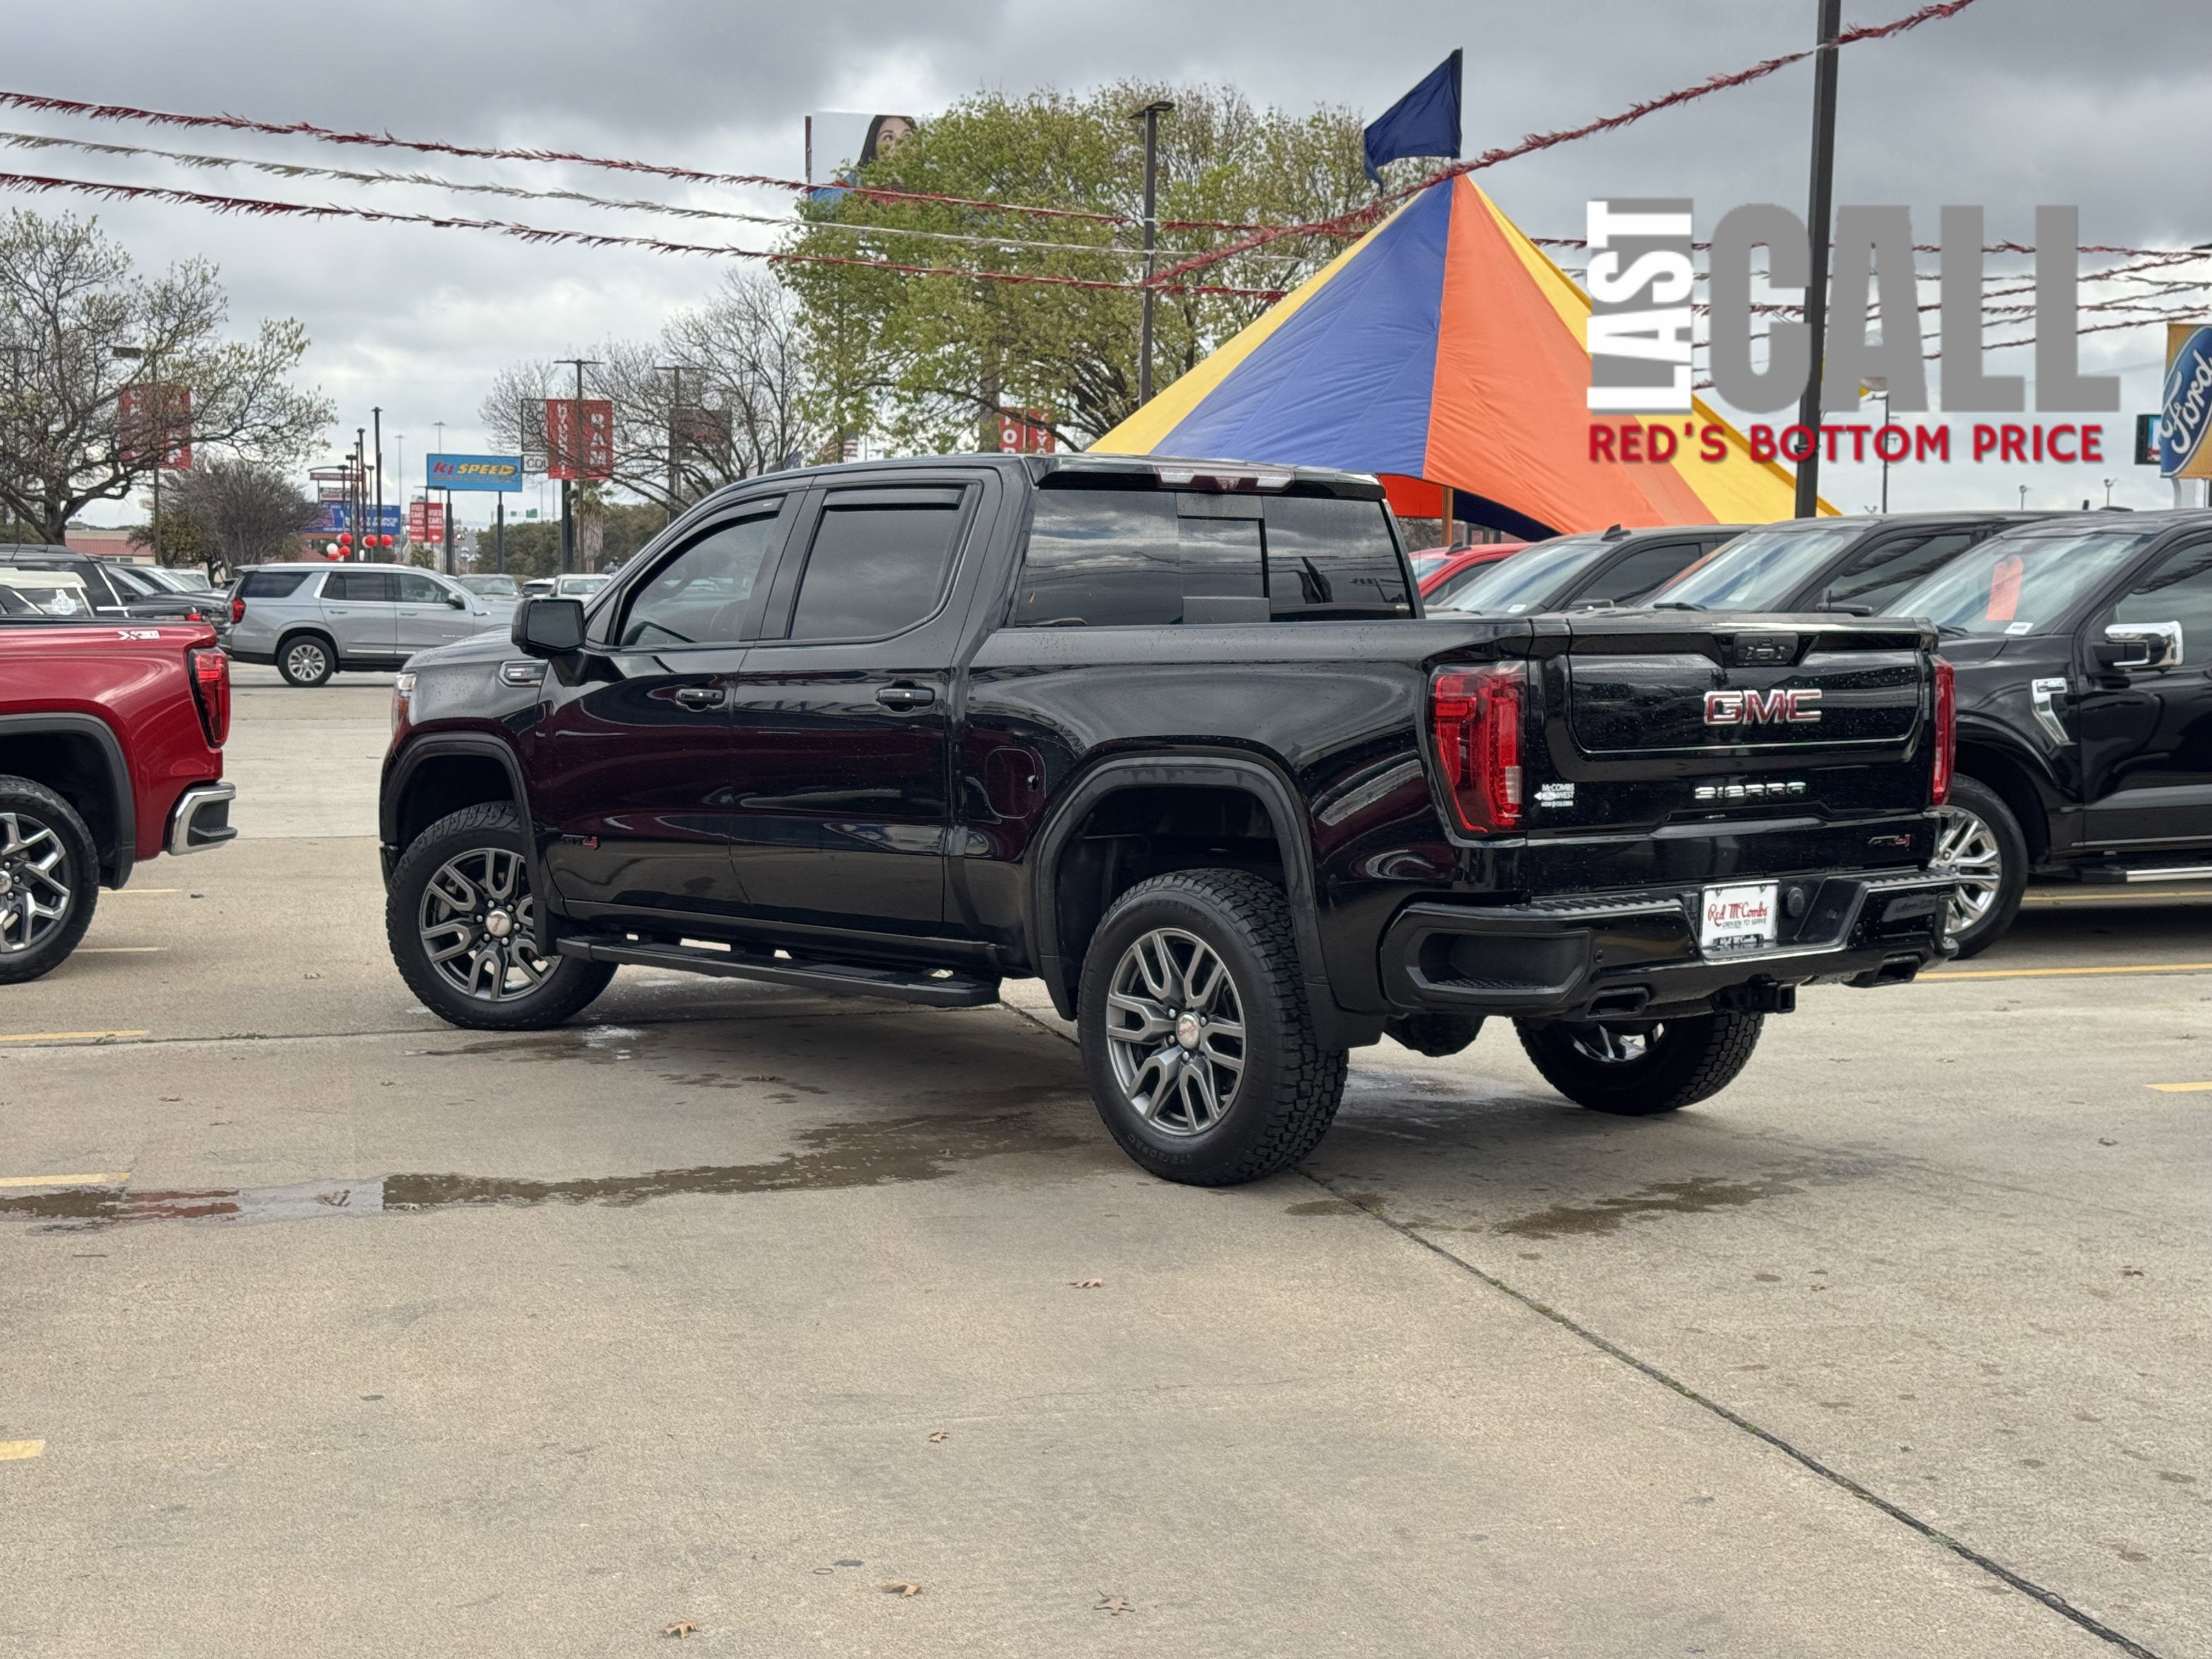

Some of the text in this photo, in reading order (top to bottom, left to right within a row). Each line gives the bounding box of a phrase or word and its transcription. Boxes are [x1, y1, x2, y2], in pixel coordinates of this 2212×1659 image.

[457, 462, 517, 476] SPEED
[1703, 689, 1822, 725] GMC
[1695, 781, 1807, 799] SIERRA
[1708, 903, 1726, 927] Red
